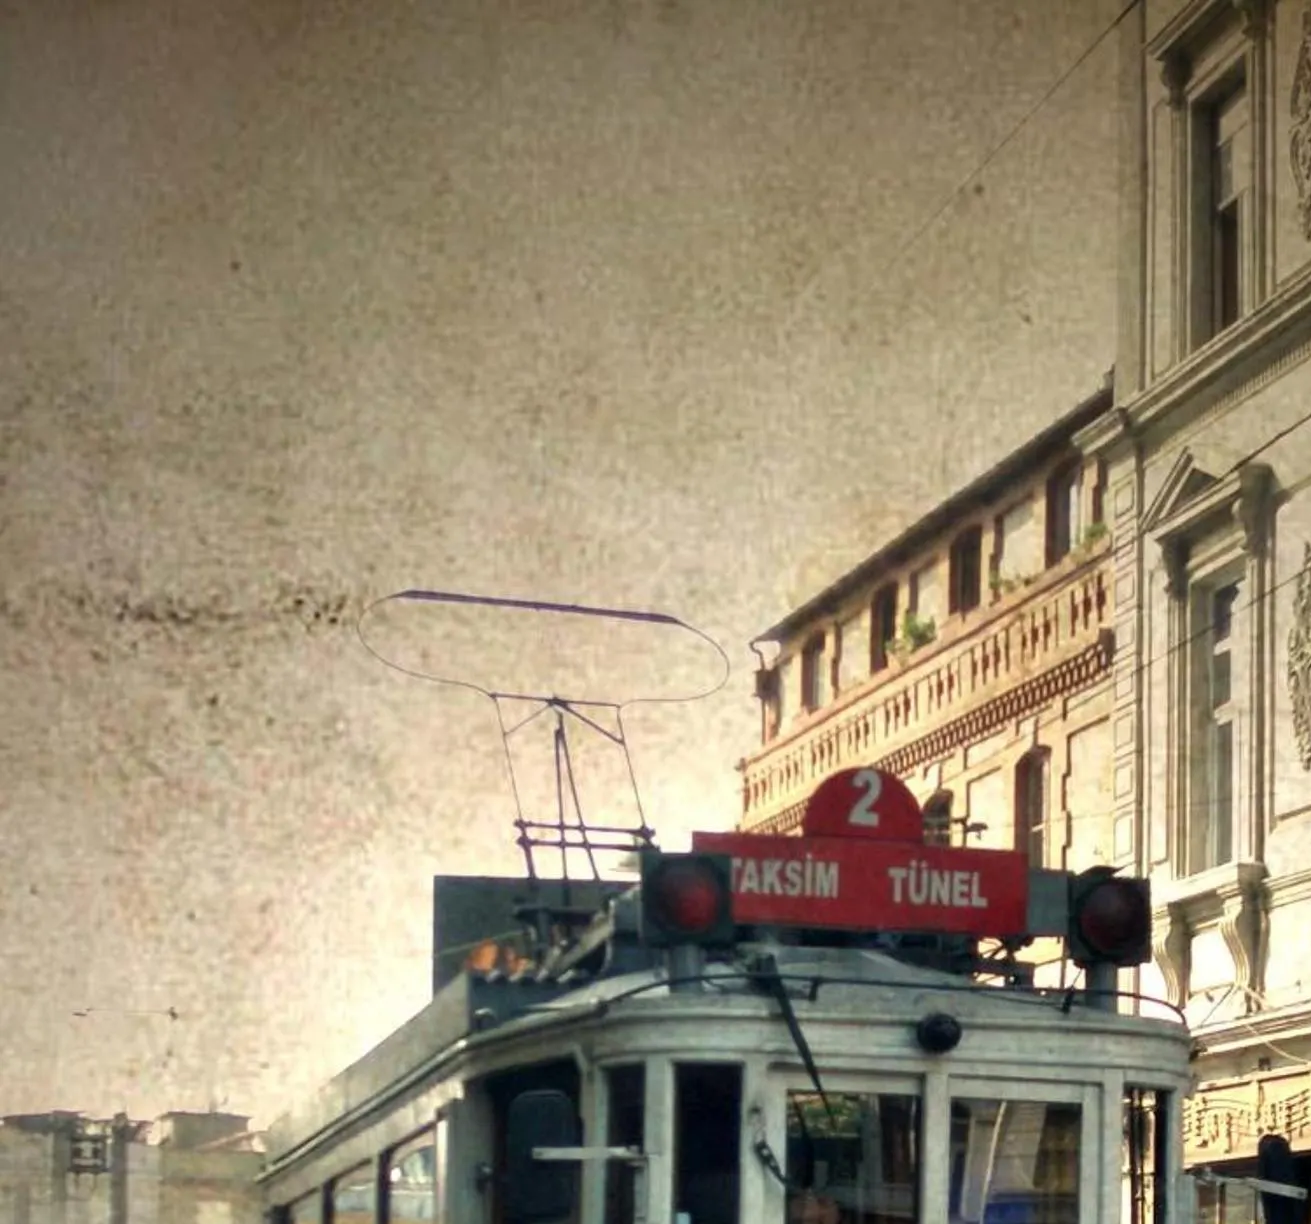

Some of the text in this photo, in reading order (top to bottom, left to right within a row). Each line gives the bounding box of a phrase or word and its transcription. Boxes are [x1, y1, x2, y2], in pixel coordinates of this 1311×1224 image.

[849, 769, 881, 827] 2
[730, 854, 988, 907] TAKSİM TÜNEL
